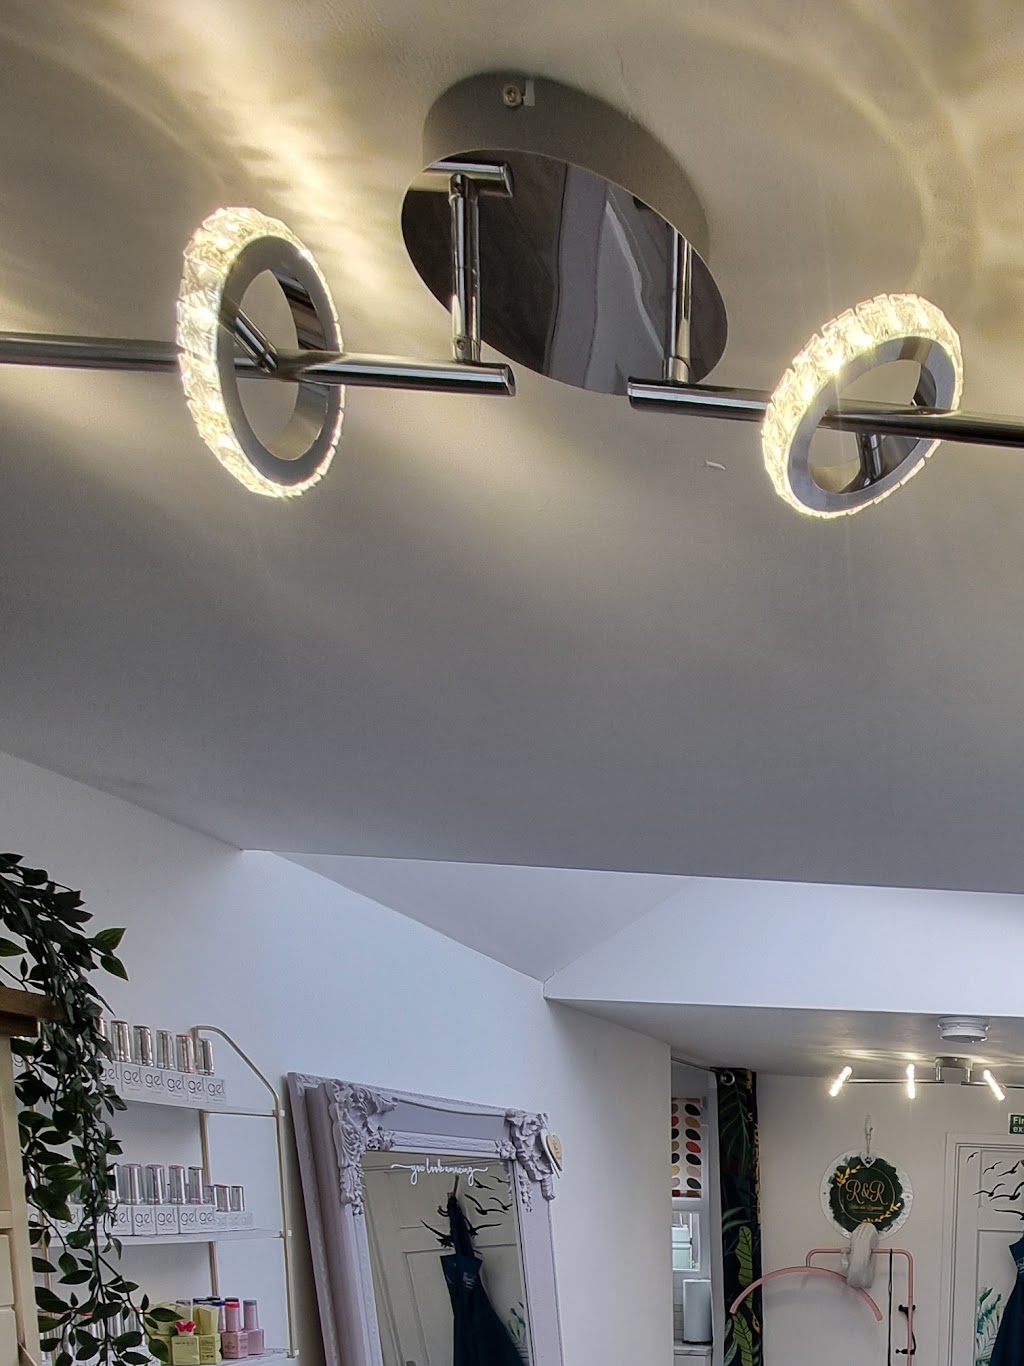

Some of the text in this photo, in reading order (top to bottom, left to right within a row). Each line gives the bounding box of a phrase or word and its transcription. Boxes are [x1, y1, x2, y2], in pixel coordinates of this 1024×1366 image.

[100, 1062, 119, 1081] gel
[123, 1066, 142, 1084] gel
[145, 1070, 164, 1088] gel
[167, 1074, 185, 1092] gel
[188, 1077, 205, 1093] gel
[208, 1080, 225, 1096] gel
[846, 1179, 888, 1205] R&R
[135, 1208, 153, 1227] gel
[157, 1208, 176, 1225] gel
[180, 1207, 198, 1225] gel
[199, 1207, 216, 1225] gel
